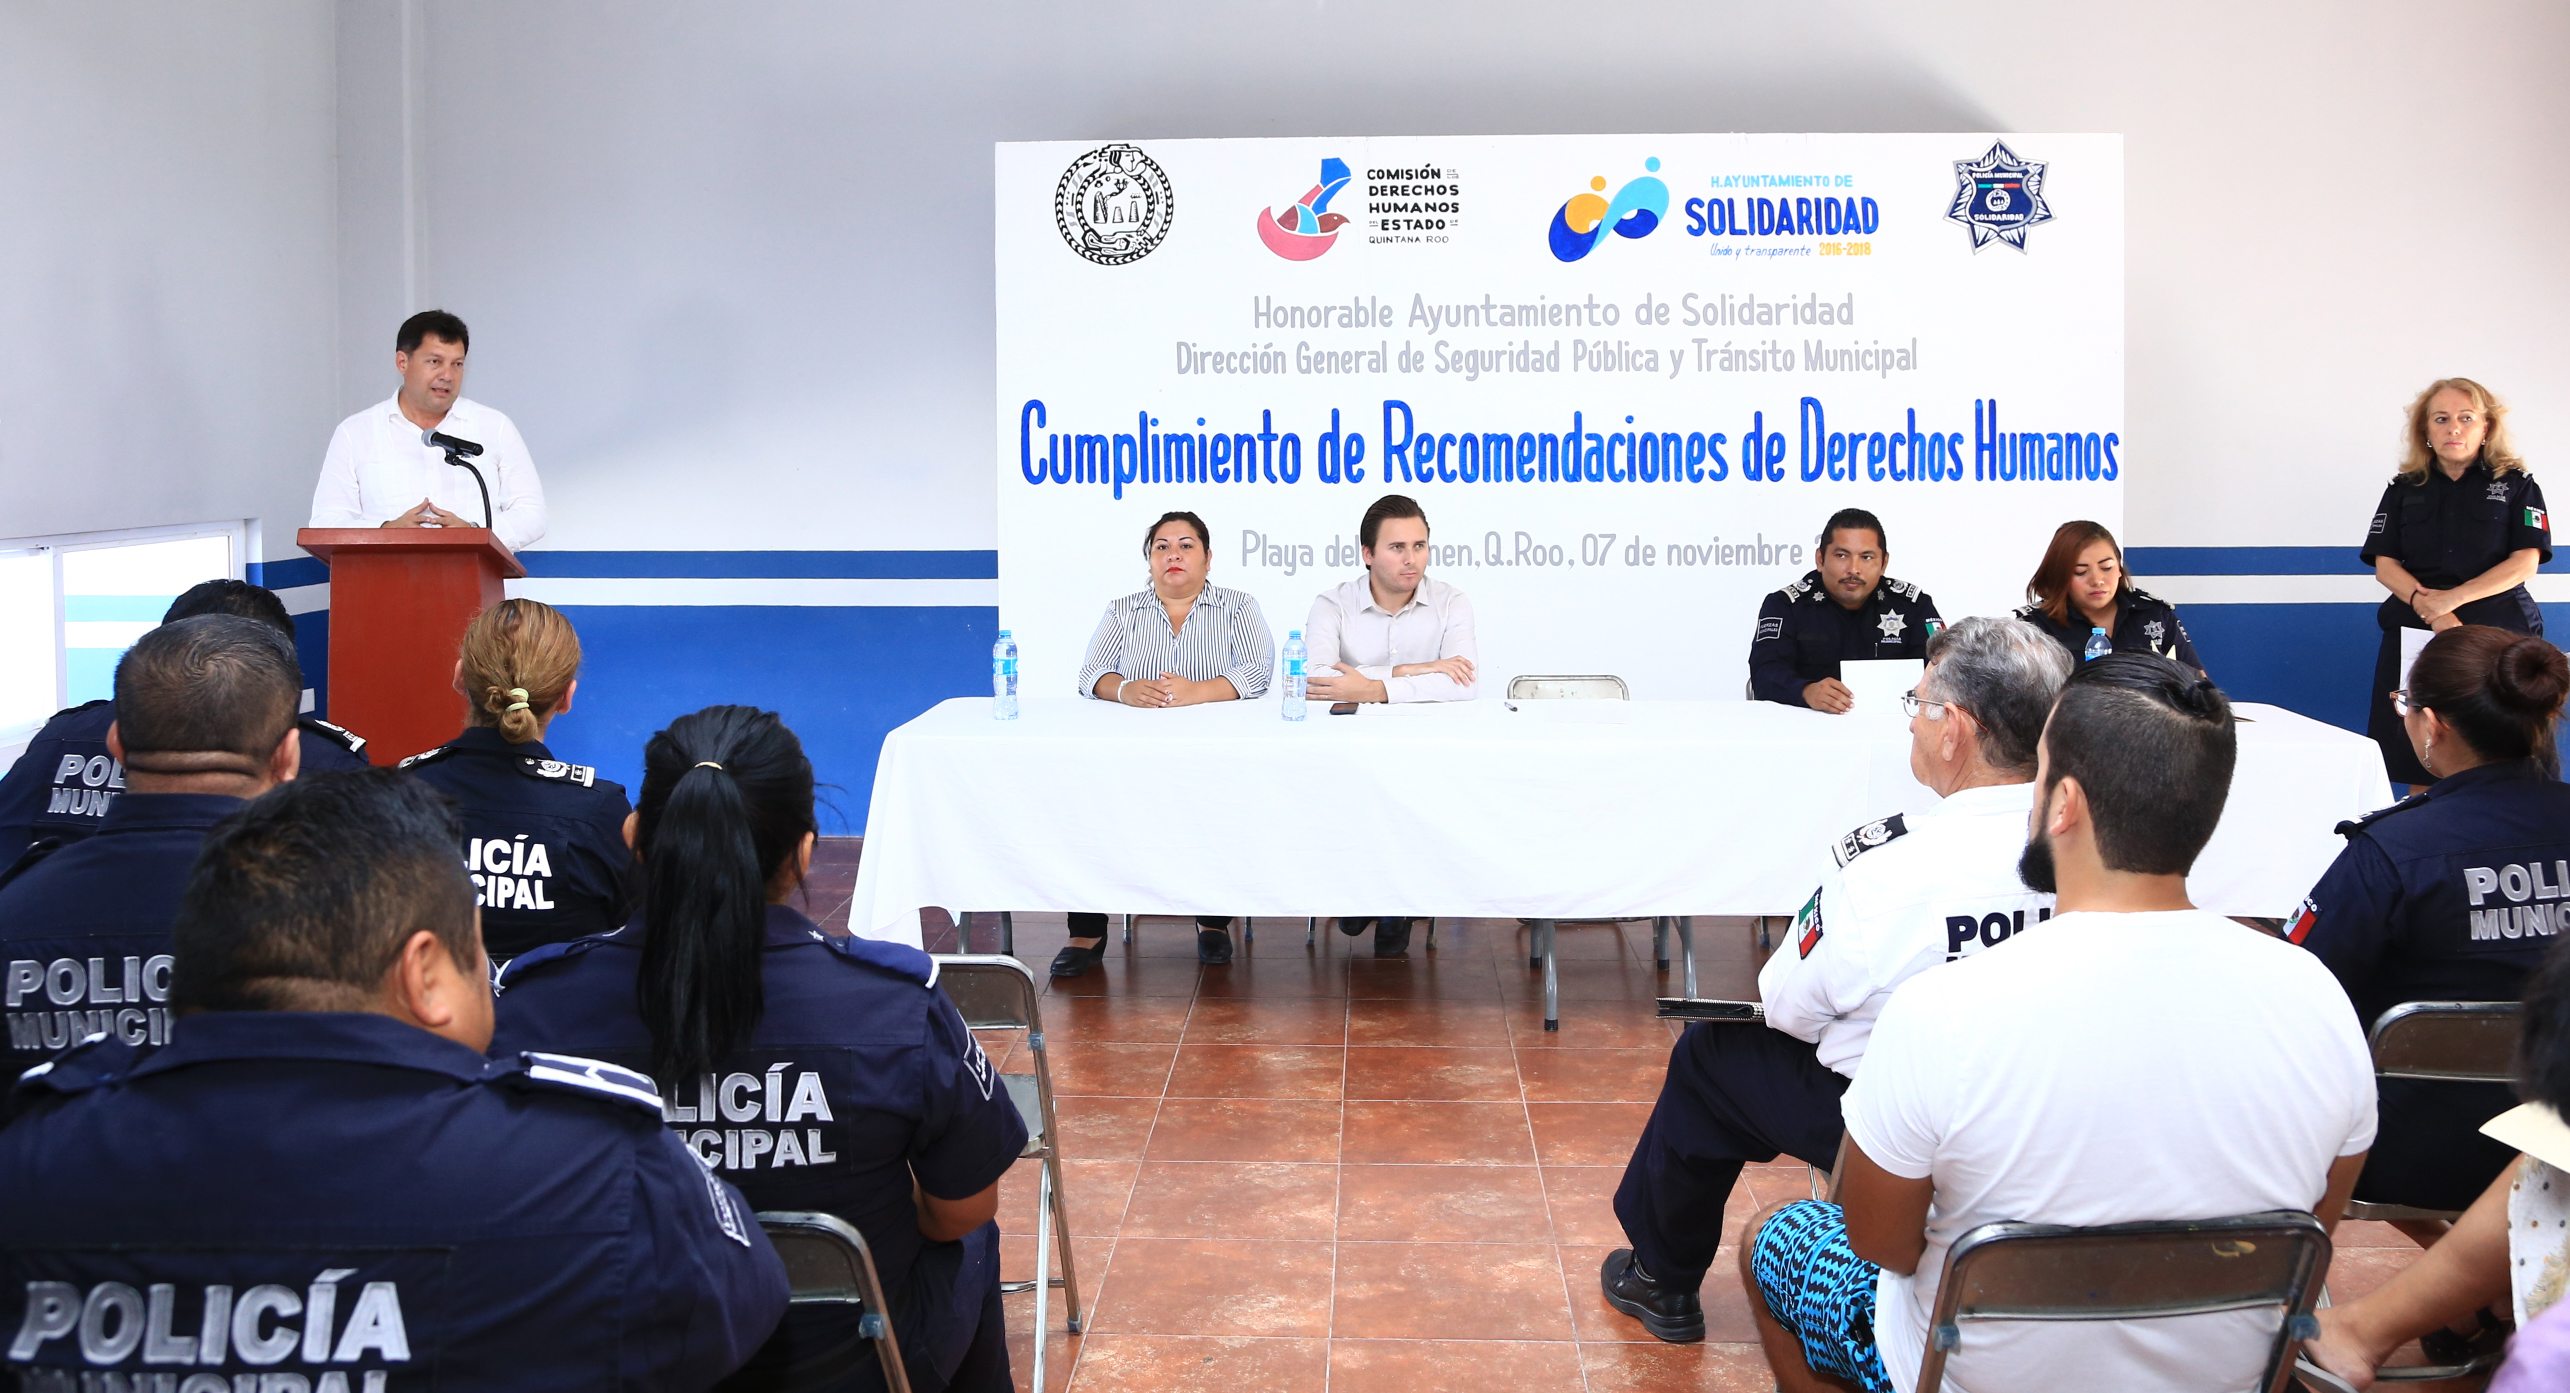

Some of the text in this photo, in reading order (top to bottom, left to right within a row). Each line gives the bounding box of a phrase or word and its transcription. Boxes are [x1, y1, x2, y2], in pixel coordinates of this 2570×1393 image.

[1367, 163, 1441, 180] COMISIÓN
[1369, 184, 1459, 197] DERECHOS
[1711, 175, 1853, 188] H.AYUNTAMIENTO DE
[1369, 202, 1459, 214] HUMANOS
[1381, 219, 1445, 231] ESTADO
[1685, 196, 1879, 237] SOLIDARIDAD
[1369, 236, 1421, 244] QUINTANA
[1736, 247, 1741, 260] y
[1745, 244, 1811, 260] transparente
[1819, 241, 1872, 256] 2016-2018
[1254, 293, 1853, 335] Honorable Ayuntamiento de Solidaridad
[1177, 338, 1917, 381] Dirección General de Seguridad Pública y Tránsito Municipal
[1021, 396, 2119, 500] Cumplimiento de Recomendaciones de Derechos Humanos
[1242, 530, 1313, 576] Playa
[1325, 535, 1360, 567] del
[1582, 534, 1616, 566] 07
[1625, 535, 1656, 566] de
[1667, 533, 1802, 566] noviembre
[54, 754, 126, 788] POL
[464, 834, 552, 877] ICÍA
[2463, 860, 2570, 906] POLI
[2470, 902, 2570, 940] MUNIC
[6, 954, 175, 1007] POLIC
[660, 1062, 834, 1122] LICÍA
[8, 1268, 411, 1365] POLICÍA
